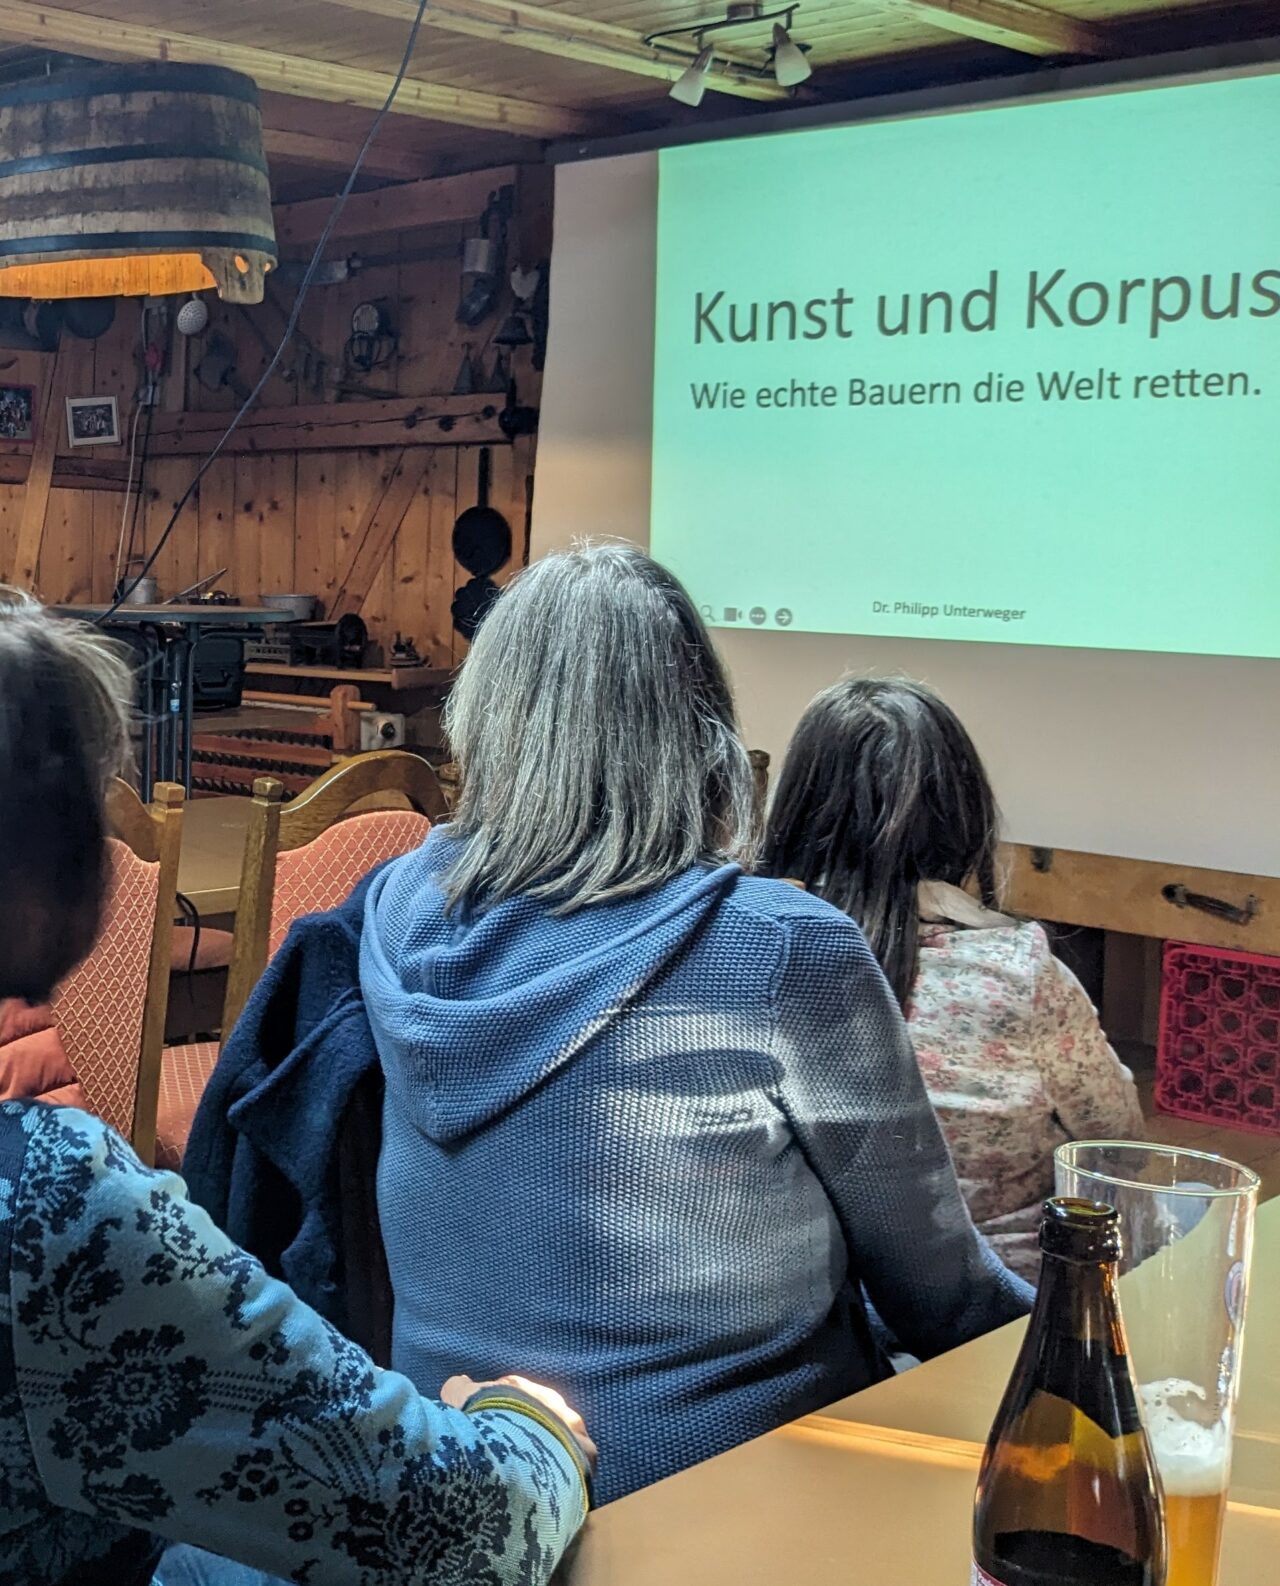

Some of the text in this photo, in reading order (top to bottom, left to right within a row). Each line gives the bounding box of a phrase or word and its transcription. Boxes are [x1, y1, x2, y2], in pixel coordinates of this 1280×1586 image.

[694, 268, 1280, 344] Kunst und Korpus
[690, 368, 1261, 409] Wie echte Bauern die Welt retten.
[872, 601, 1026, 622] Dr. Philipp Unterweger
